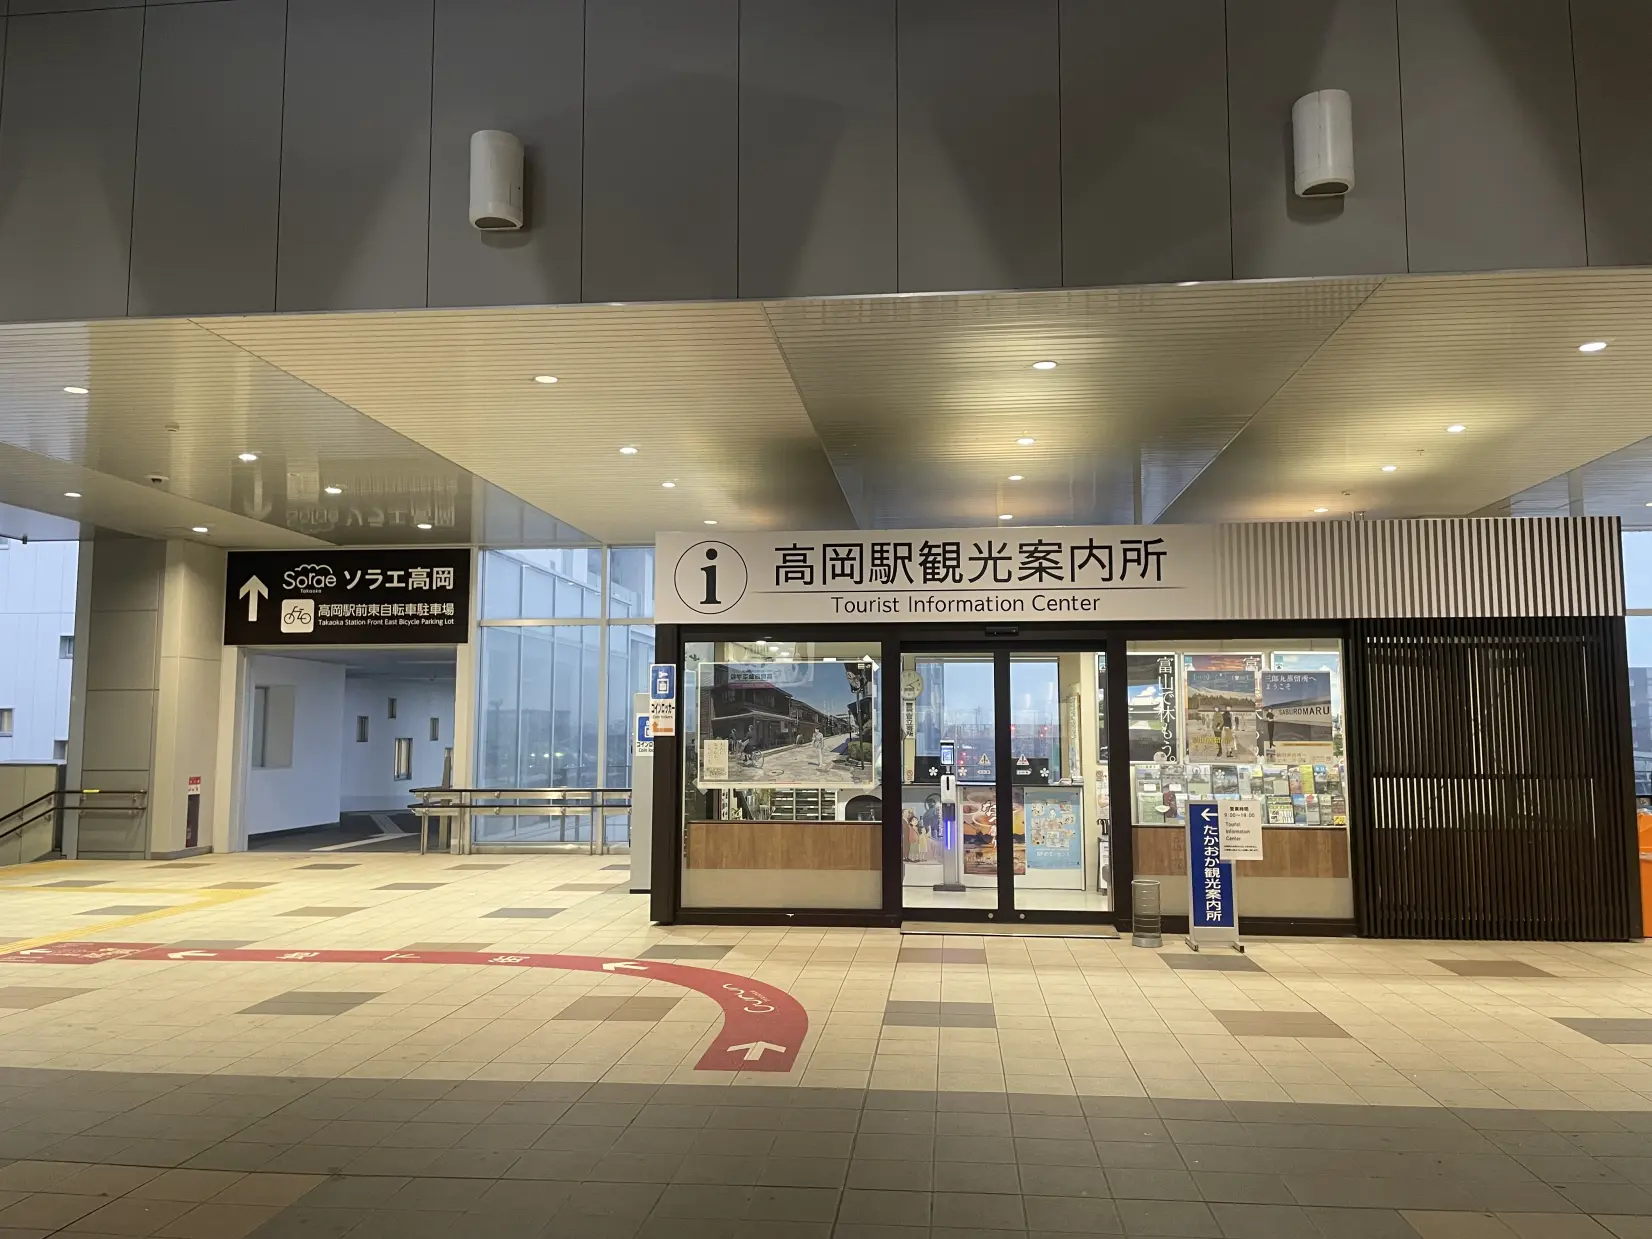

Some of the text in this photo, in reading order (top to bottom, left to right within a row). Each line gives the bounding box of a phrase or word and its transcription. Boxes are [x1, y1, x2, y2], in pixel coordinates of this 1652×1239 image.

[774, 538, 1168, 586] 高岡駅観光案内所
[283, 570, 337, 590] Sorae
[343, 567, 455, 590] ソラエ高岡
[318, 603, 455, 617] 高岡駅前東自転車駐車場
[831, 594, 1101, 615] Tourist Information Center
[421, 618, 443, 626] Parking
[1156, 656, 1177, 763] 富山で休もう。
[1279, 706, 1331, 716] SABUROMARU
[1203, 824, 1223, 922] たかおか観光案内所
